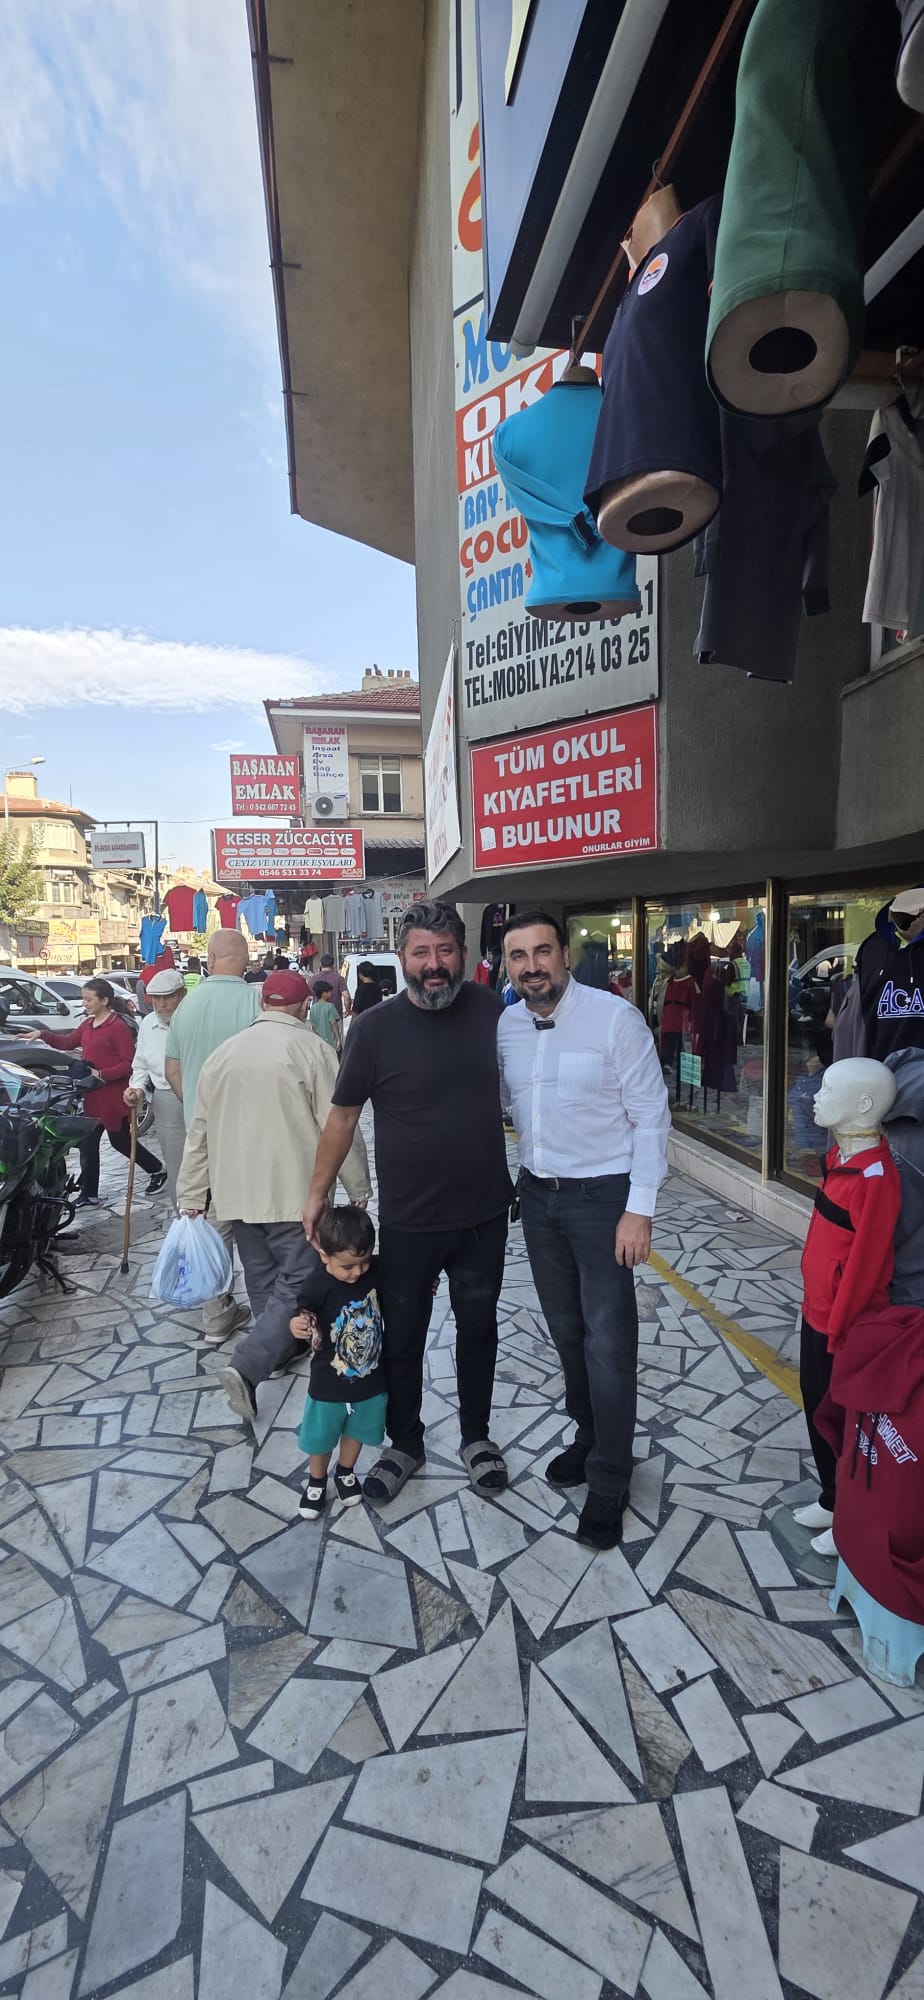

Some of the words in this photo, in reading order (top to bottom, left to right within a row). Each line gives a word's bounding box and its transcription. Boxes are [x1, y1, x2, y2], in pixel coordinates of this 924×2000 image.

[464, 435, 495, 486] KI
[460, 515, 528, 578] ÇOCU
[467, 562, 523, 623] ÇANTA
[601, 634, 622, 672] 03
[628, 626, 650, 665] 25
[305, 727, 345, 736] BAŞARAN
[232, 759, 295, 779] BAŞARAN
[494, 745, 545, 777] TÜM
[552, 727, 626, 765] OKUL
[235, 783, 296, 800] EMLAK
[483, 757, 642, 816] KIYAFETLERİ
[226, 832, 271, 845] KESER
[275, 830, 353, 845] ZÜCCACİYE
[502, 808, 622, 848] BULUNUR
[582, 842, 622, 854] ONURLAR
[624, 837, 650, 848] GİYİM
[258, 859, 270, 867] VE
[271, 859, 309, 867] MUTFAK
[311, 859, 352, 868] EŞYALARI
